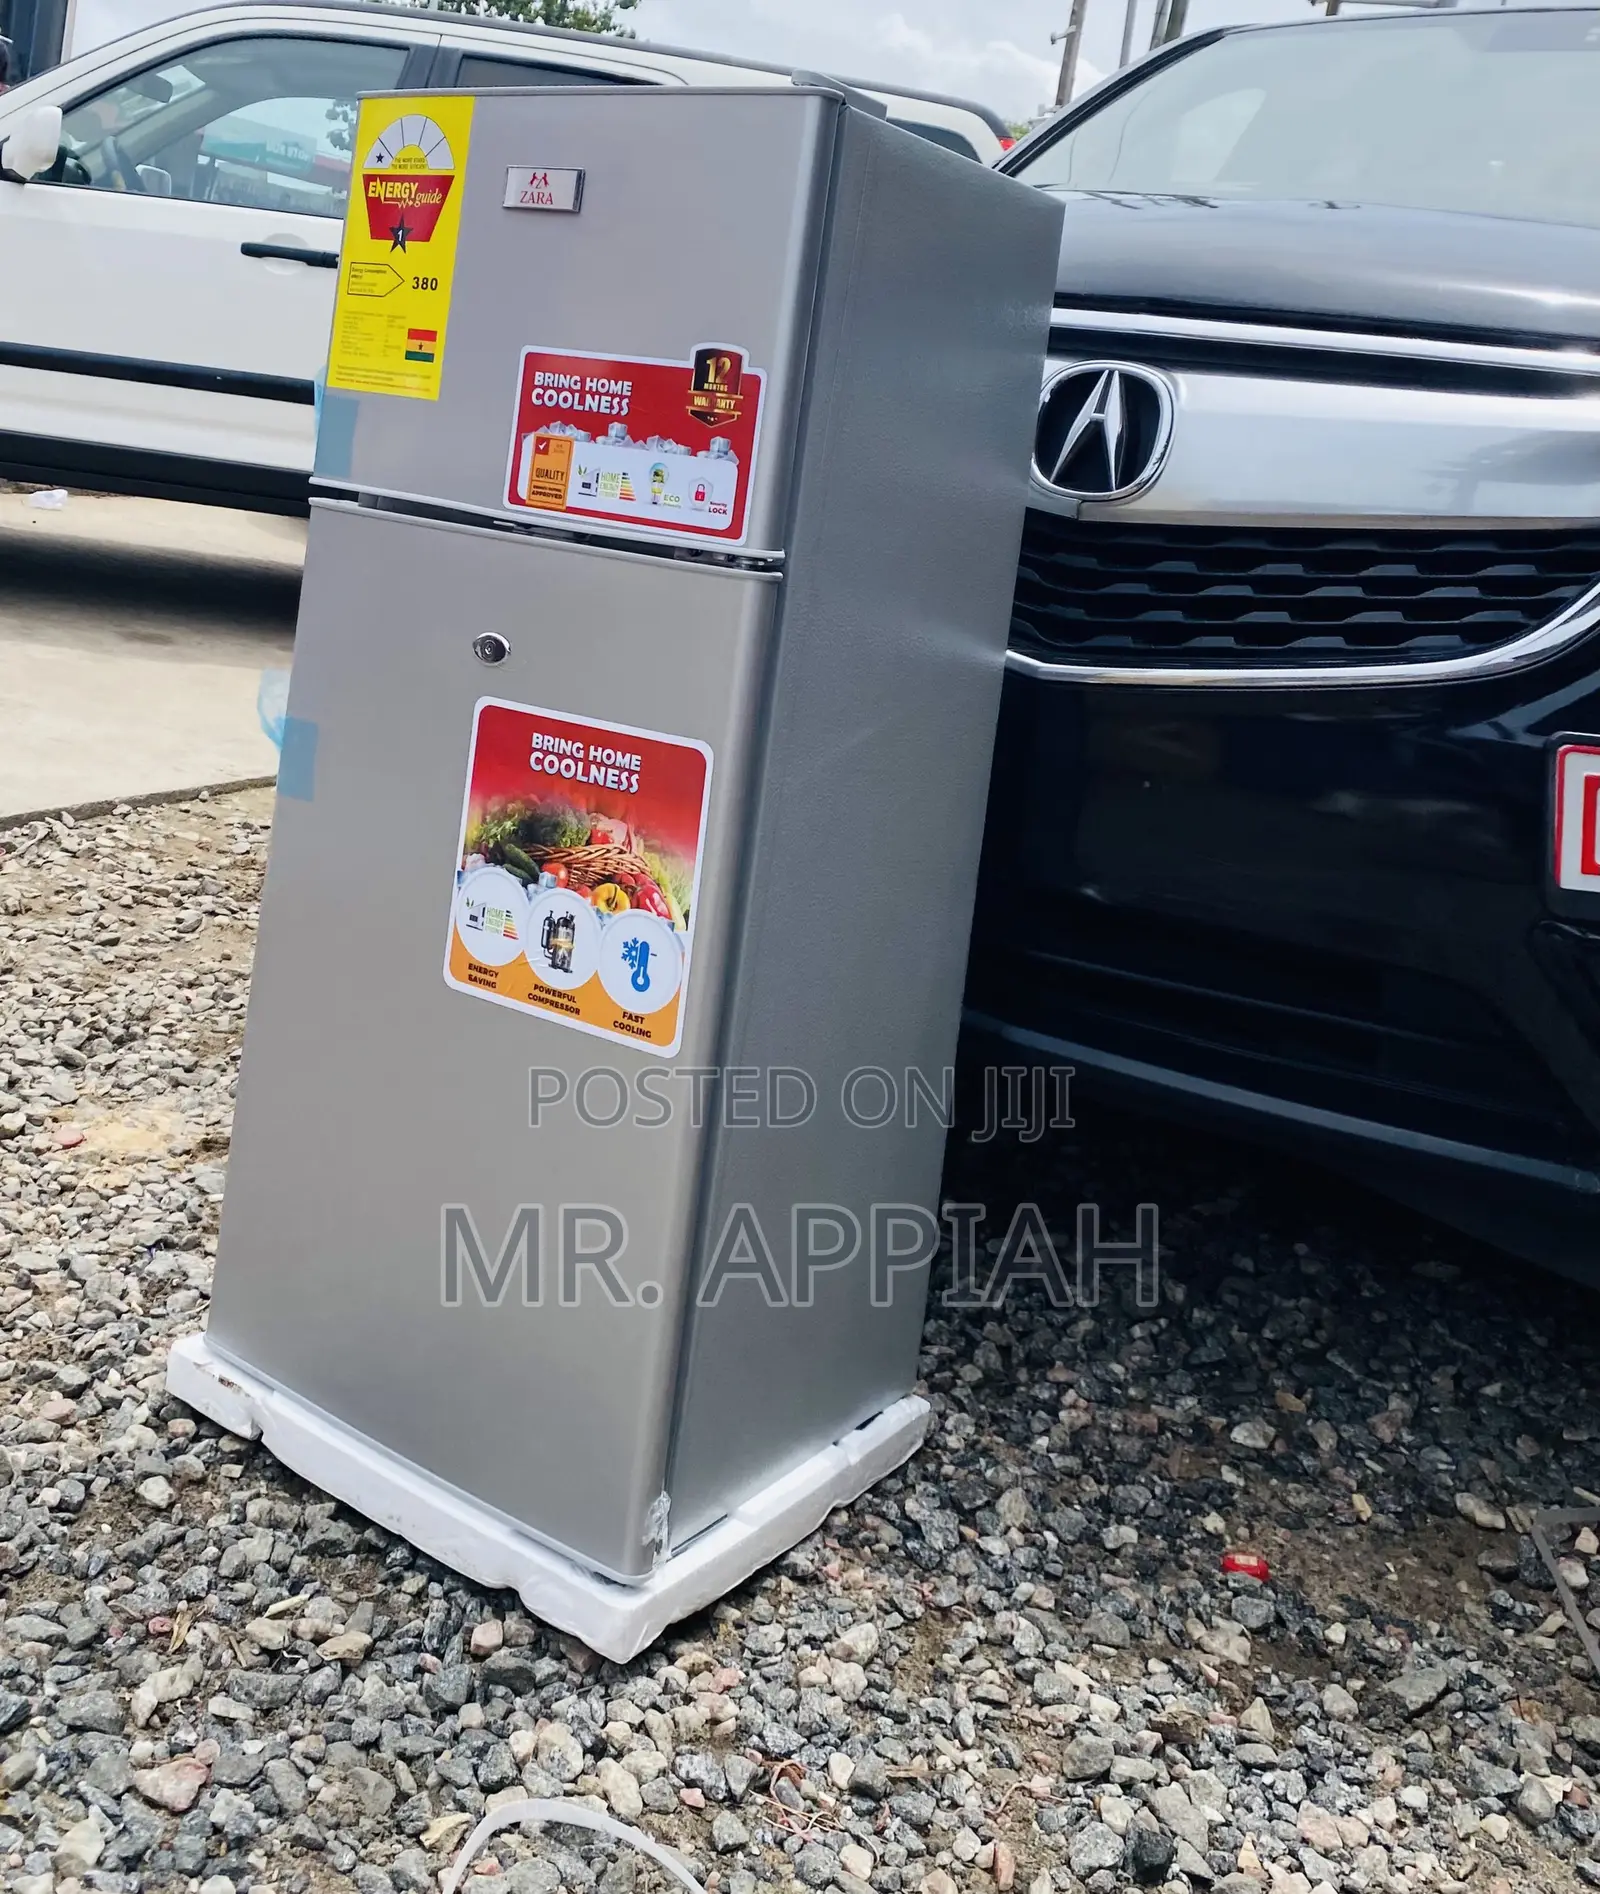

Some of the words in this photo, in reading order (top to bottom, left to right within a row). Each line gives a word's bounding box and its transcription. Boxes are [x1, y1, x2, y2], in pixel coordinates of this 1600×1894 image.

[367, 176, 419, 204] ENERGY
[413, 187, 443, 208] guide
[520, 190, 554, 206] ZARA
[397, 229, 403, 242] 1
[412, 276, 439, 291] 380
[706, 357, 731, 384] 12
[533, 371, 582, 390] BRING
[584, 377, 633, 397] HOME
[531, 387, 630, 417] COOLNESS
[693, 395, 736, 410] WAANTY
[535, 467, 565, 481] QUALITY
[531, 490, 563, 500] APPROVED
[663, 494, 681, 503] ECO
[708, 507, 728, 515] LOCK
[531, 732, 585, 759] BRING
[588, 745, 642, 772] HOME
[529, 751, 640, 794] COOLNESS
[468, 963, 500, 979] ENERGY
[467, 974, 497, 989] SAVING
[533, 983, 577, 1004] POWERFUL
[527, 992, 581, 1016] COMPRESSOR
[622, 1011, 646, 1025] FAST
[612, 1020, 652, 1038] COOLING
